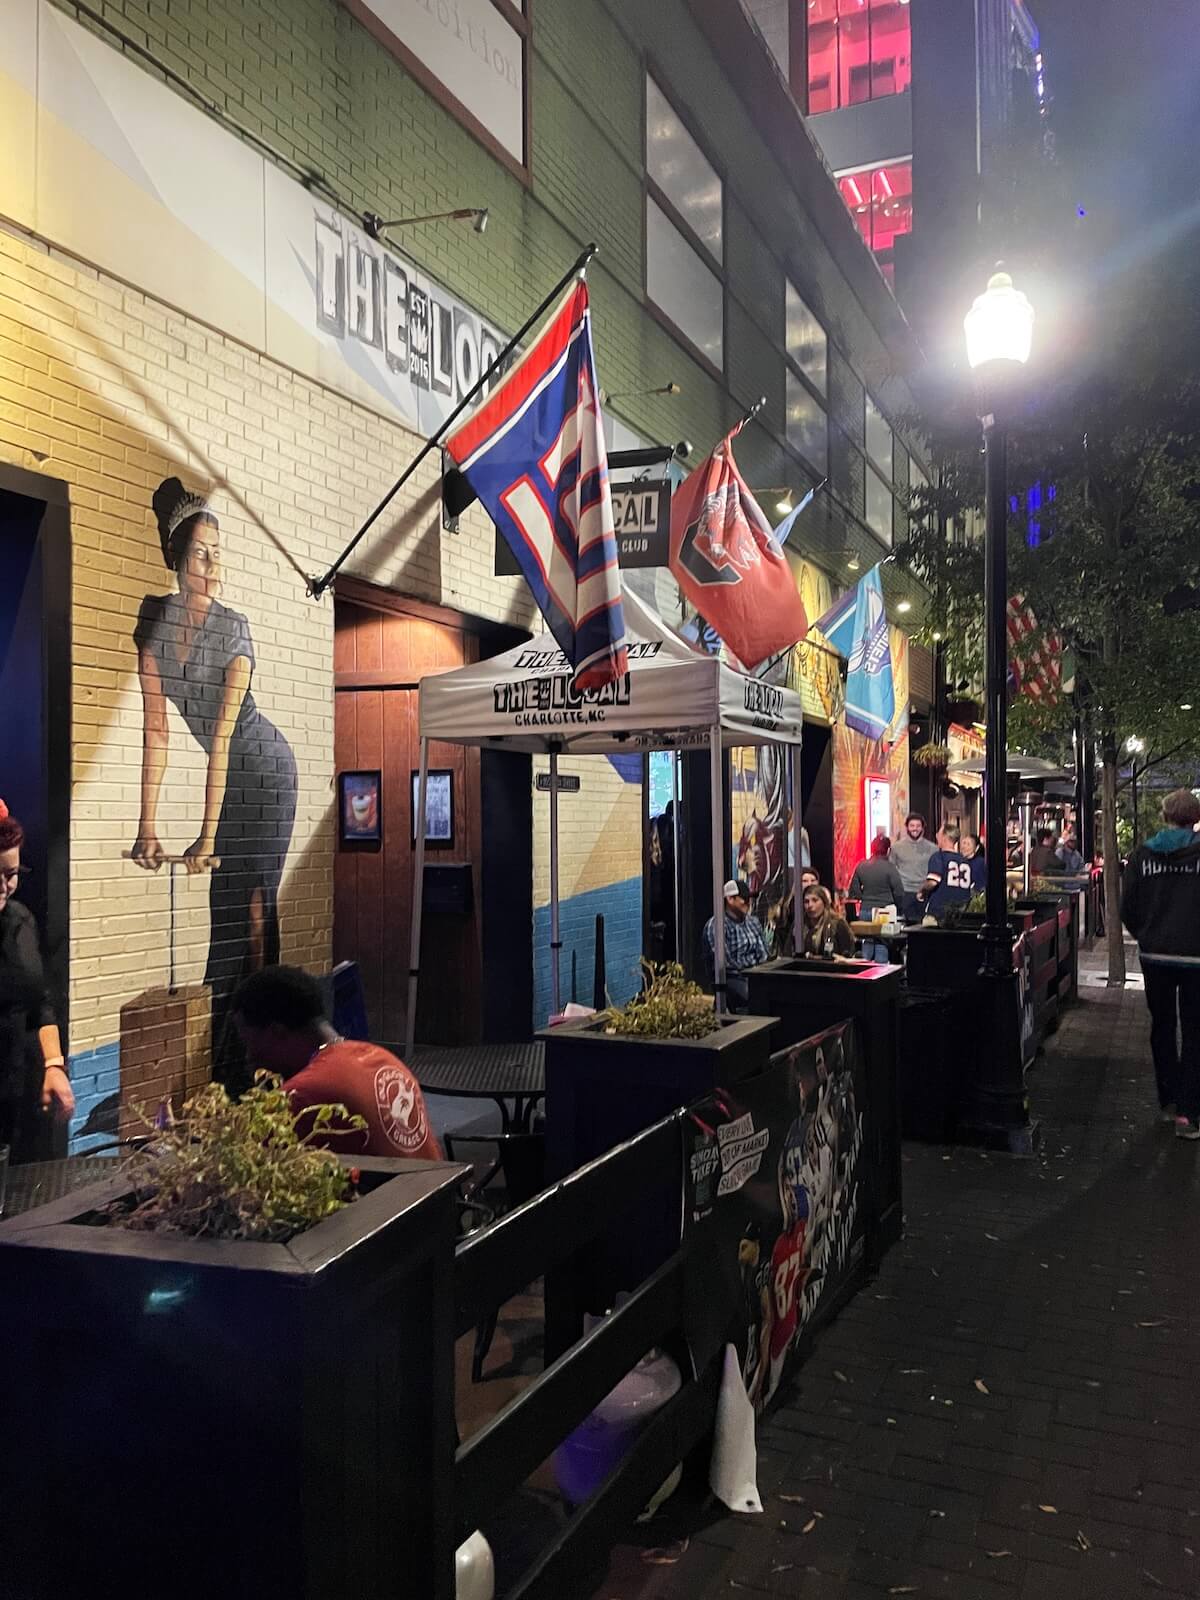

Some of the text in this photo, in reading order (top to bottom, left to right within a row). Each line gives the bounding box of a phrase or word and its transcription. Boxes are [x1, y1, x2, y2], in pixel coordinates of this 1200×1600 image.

[315, 216, 410, 374] THE
[410, 292, 428, 318] EST
[409, 351, 430, 379] 2015
[621, 538, 649, 554] CLUB
[494, 678, 541, 713] THE
[946, 860, 971, 890] 23
